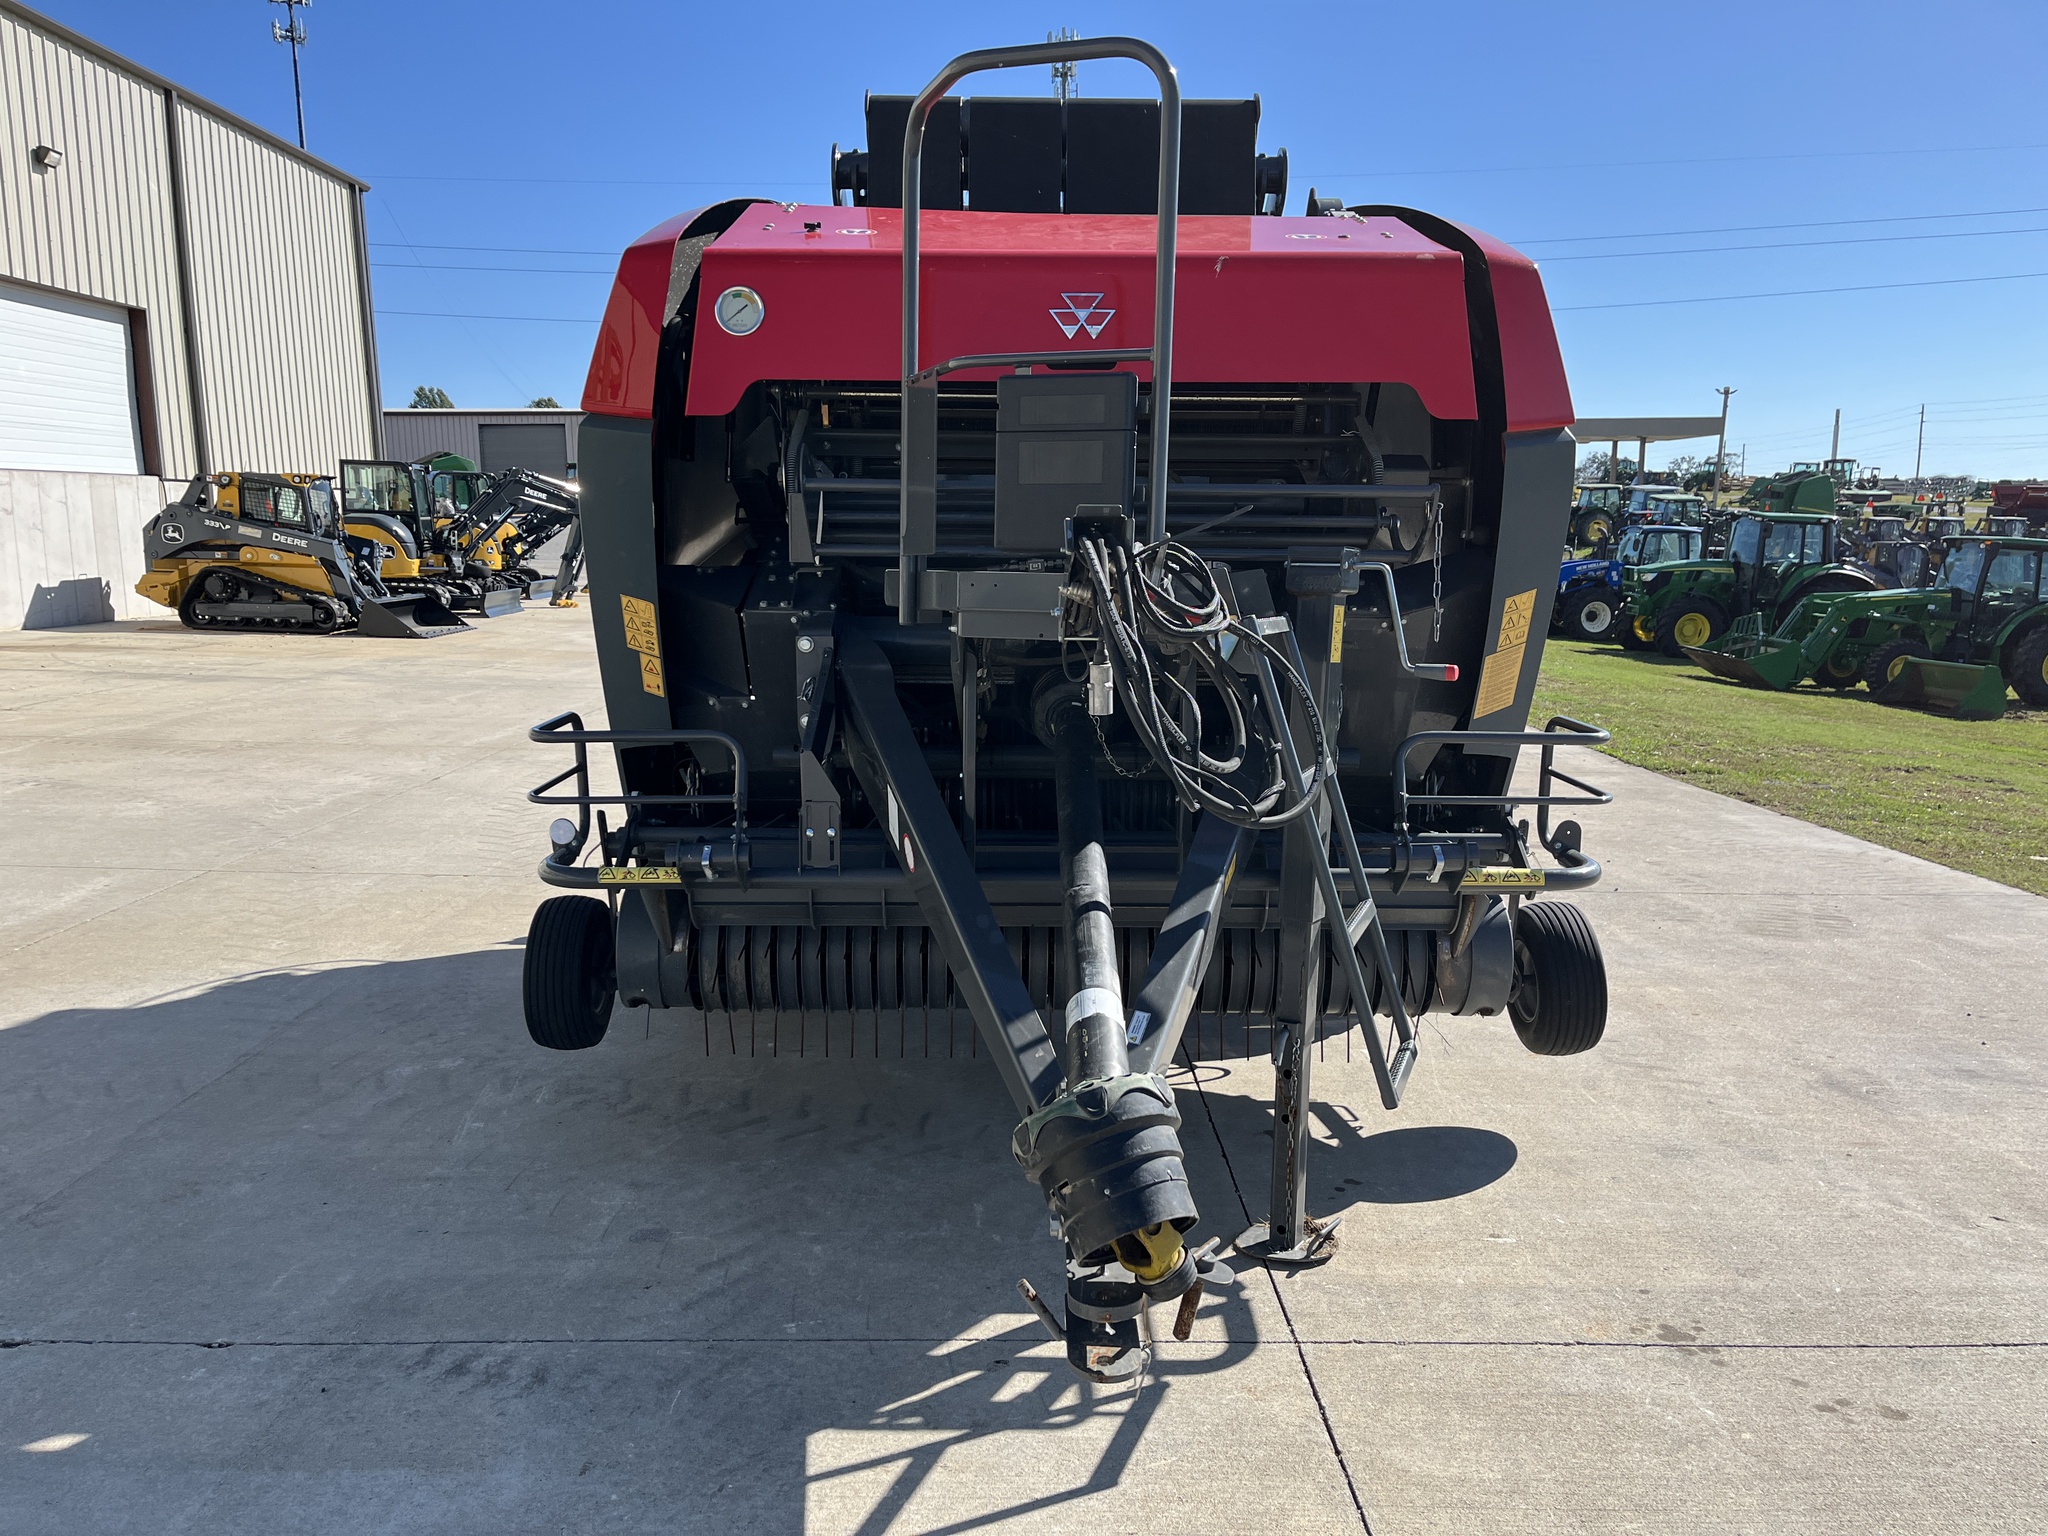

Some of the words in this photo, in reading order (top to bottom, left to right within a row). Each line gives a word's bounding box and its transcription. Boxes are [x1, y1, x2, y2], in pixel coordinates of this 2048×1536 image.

[523, 486, 548, 500] DEERE
[271, 532, 308, 548] DEERE
[1286, 670, 1308, 699] HANSA-FLEX
[1162, 716, 1186, 745] HANSA-FLEX
